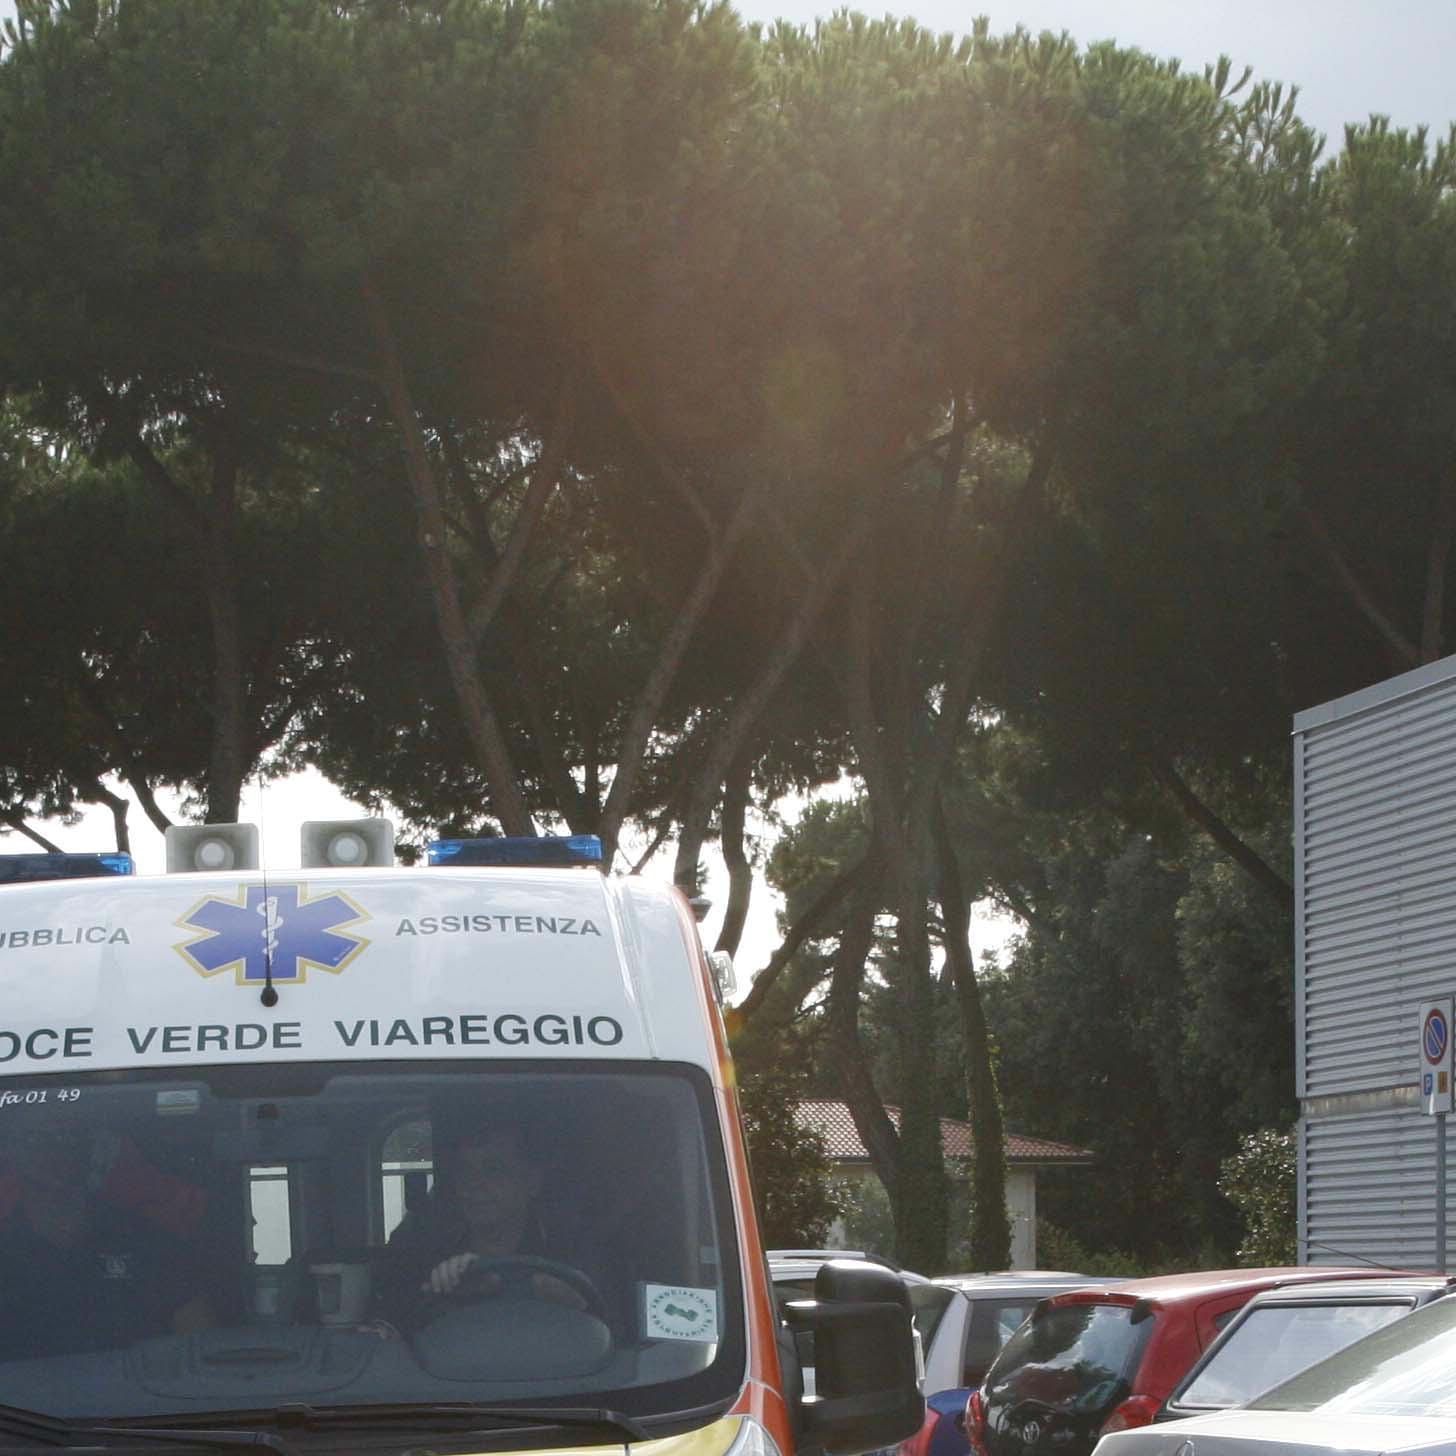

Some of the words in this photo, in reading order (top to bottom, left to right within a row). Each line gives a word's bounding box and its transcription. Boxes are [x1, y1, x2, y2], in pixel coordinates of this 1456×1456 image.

[394, 914, 603, 937] ASSISTENZA
[126, 1021, 303, 1055] VERDE
[333, 1013, 624, 1047] VIAREGGIO
[25, 1090, 47, 1104] 01
[56, 1088, 81, 1102] 49
